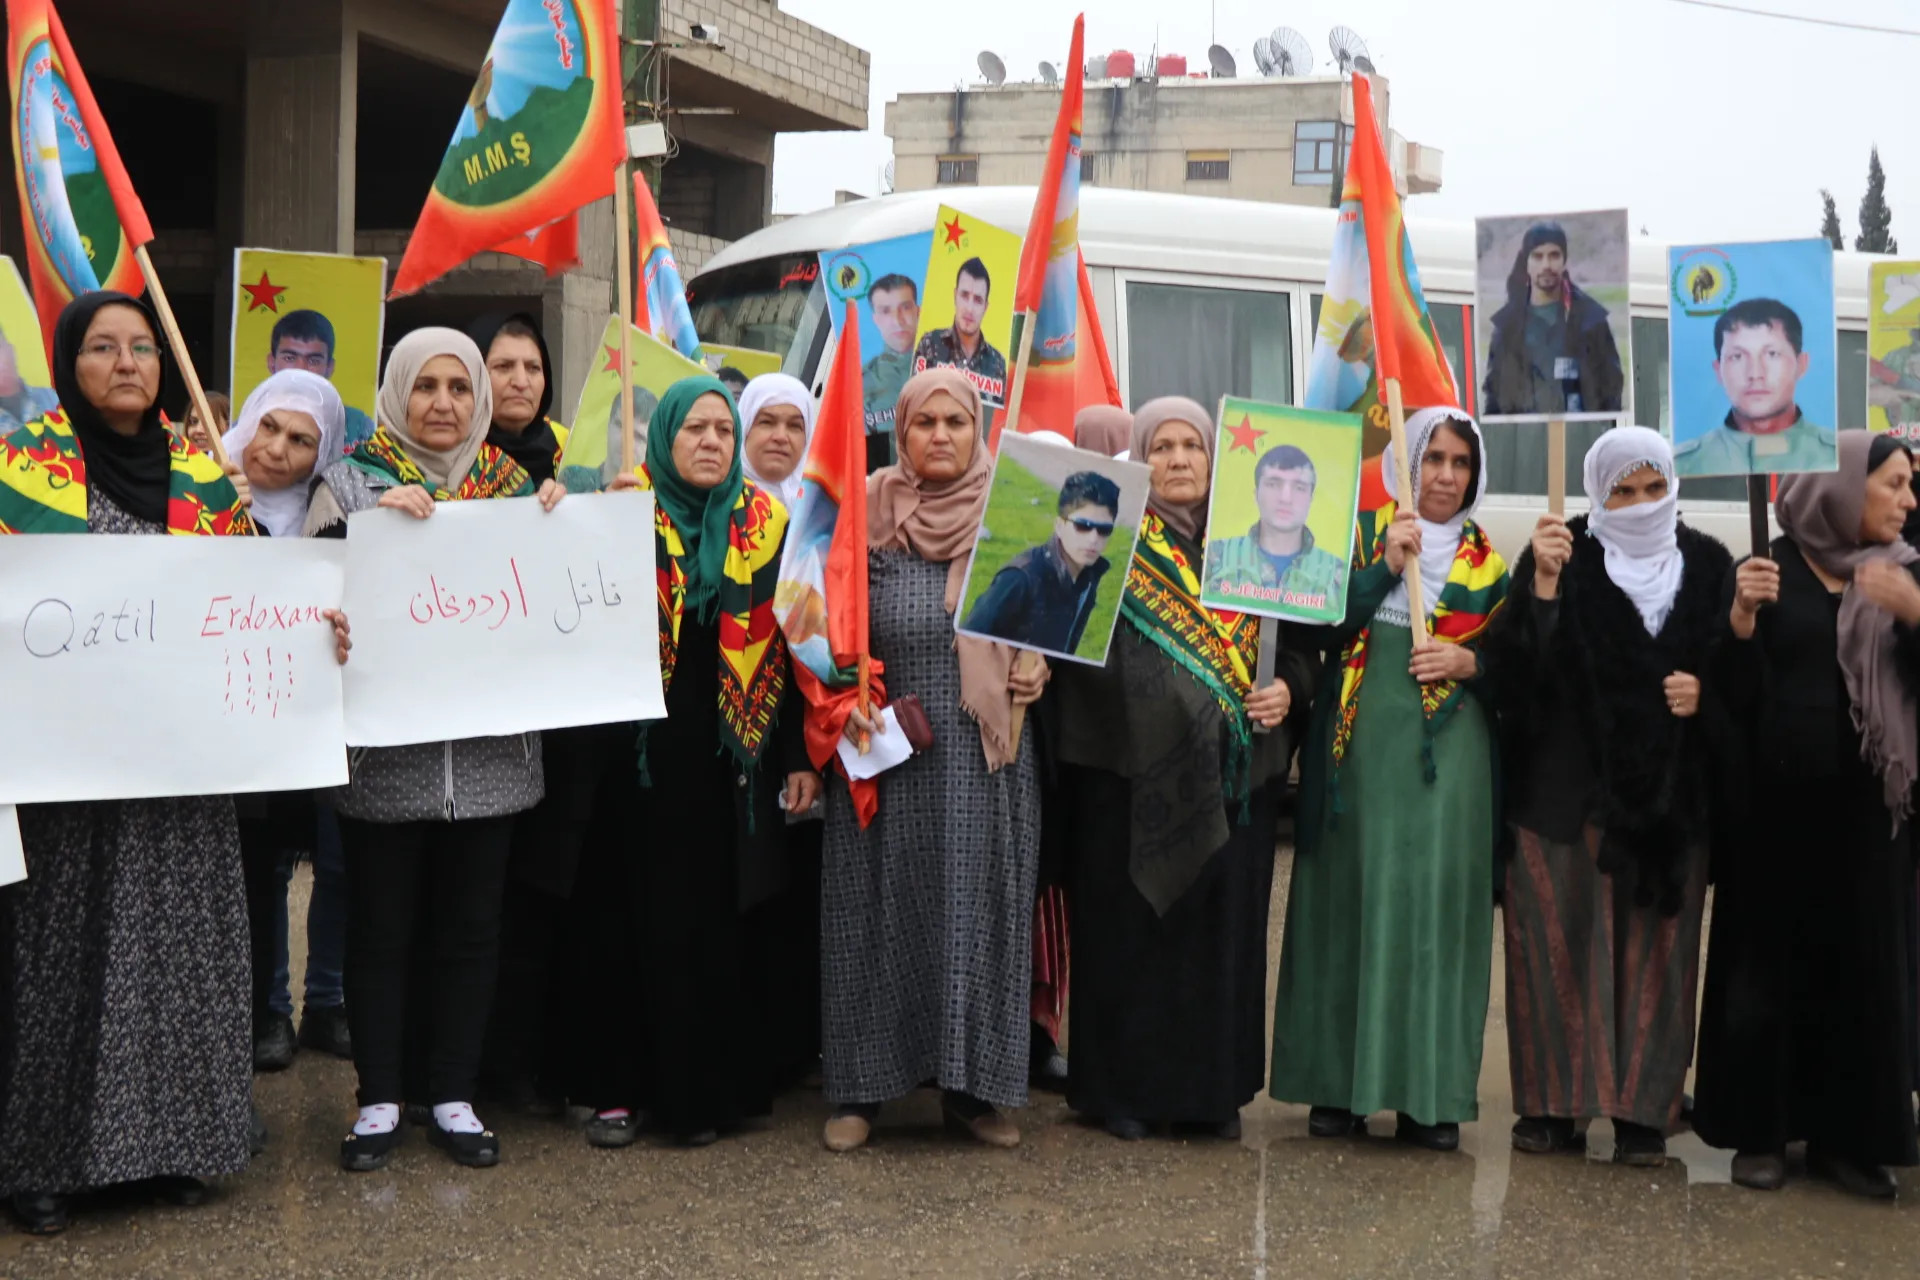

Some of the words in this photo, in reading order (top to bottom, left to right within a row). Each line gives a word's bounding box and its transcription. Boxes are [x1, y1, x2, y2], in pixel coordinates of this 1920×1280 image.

[463, 131, 531, 186] M.M.Ş
[23, 597, 156, 659] Qatil
[201, 594, 322, 637] Erdoxan
[553, 560, 622, 634] قاتل
